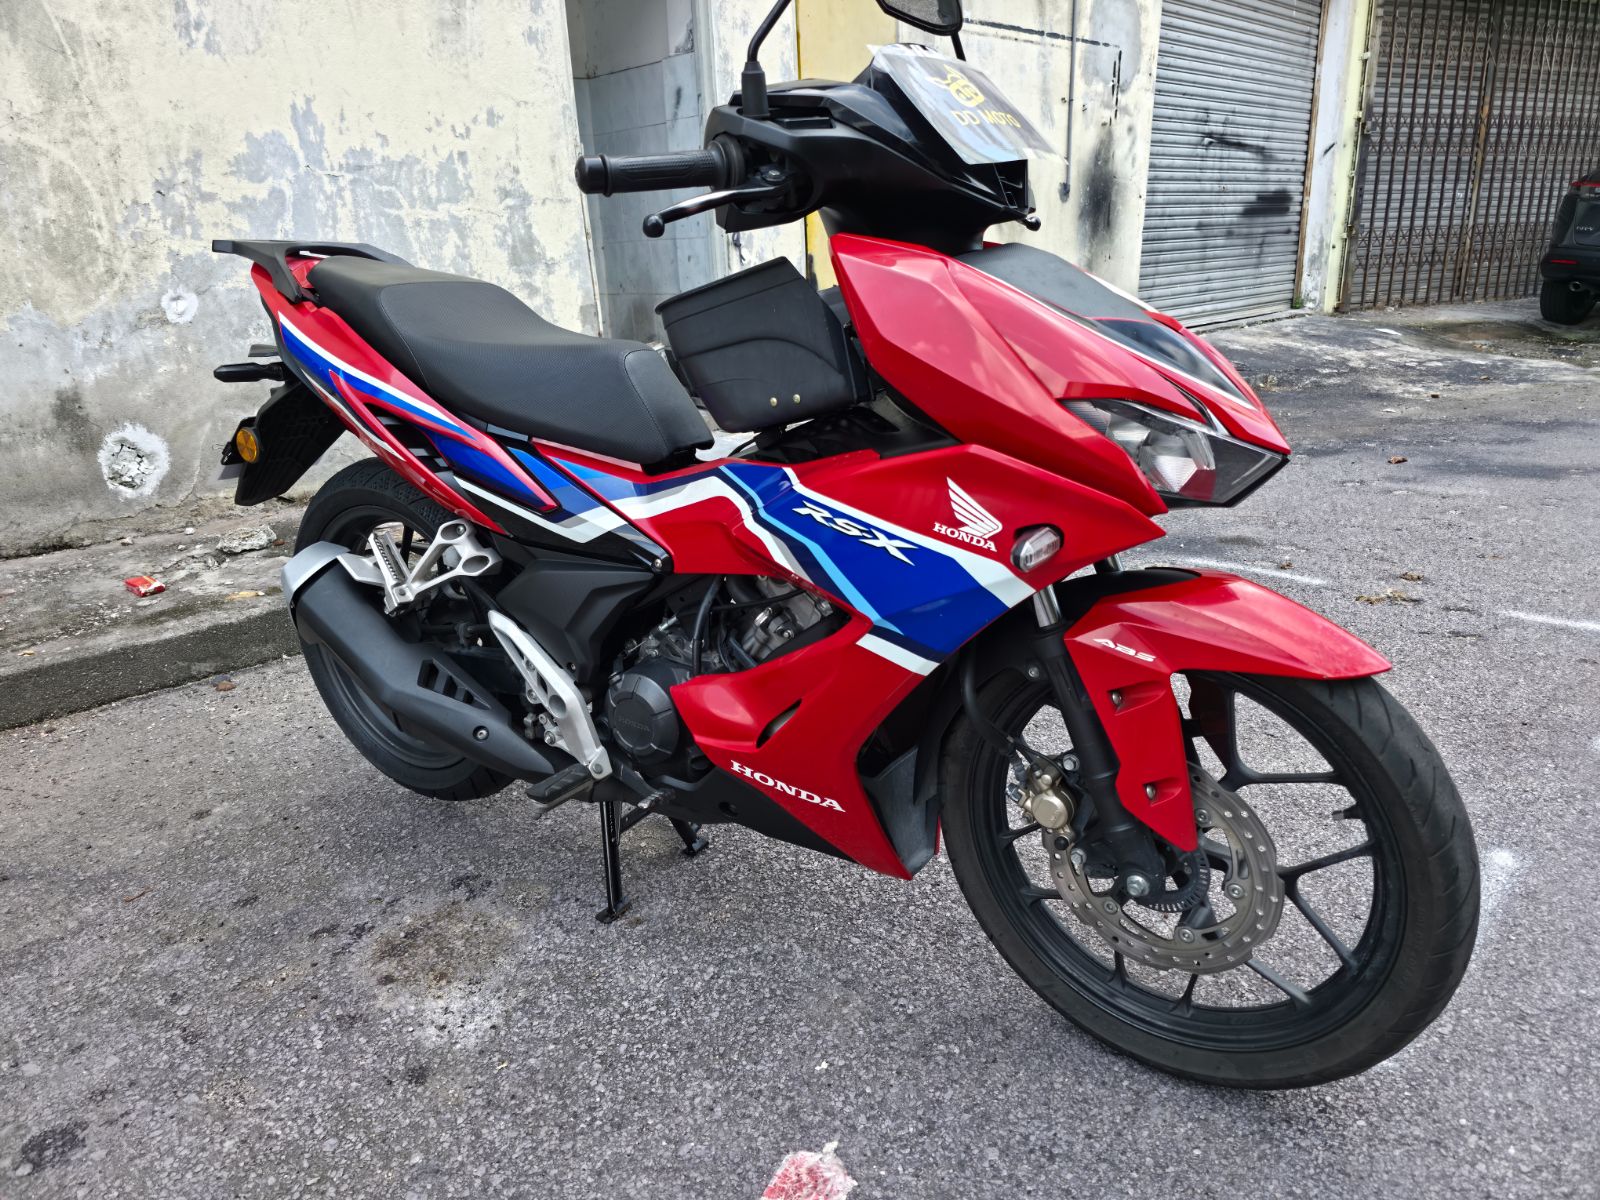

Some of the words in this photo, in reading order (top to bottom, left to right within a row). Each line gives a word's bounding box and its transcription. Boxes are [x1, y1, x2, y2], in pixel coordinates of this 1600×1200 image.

[977, 109, 1021, 128] MOTO
[933, 522, 997, 552] HONDA
[1092, 638, 1156, 662] ABS
[730, 759, 846, 813] HONDA
